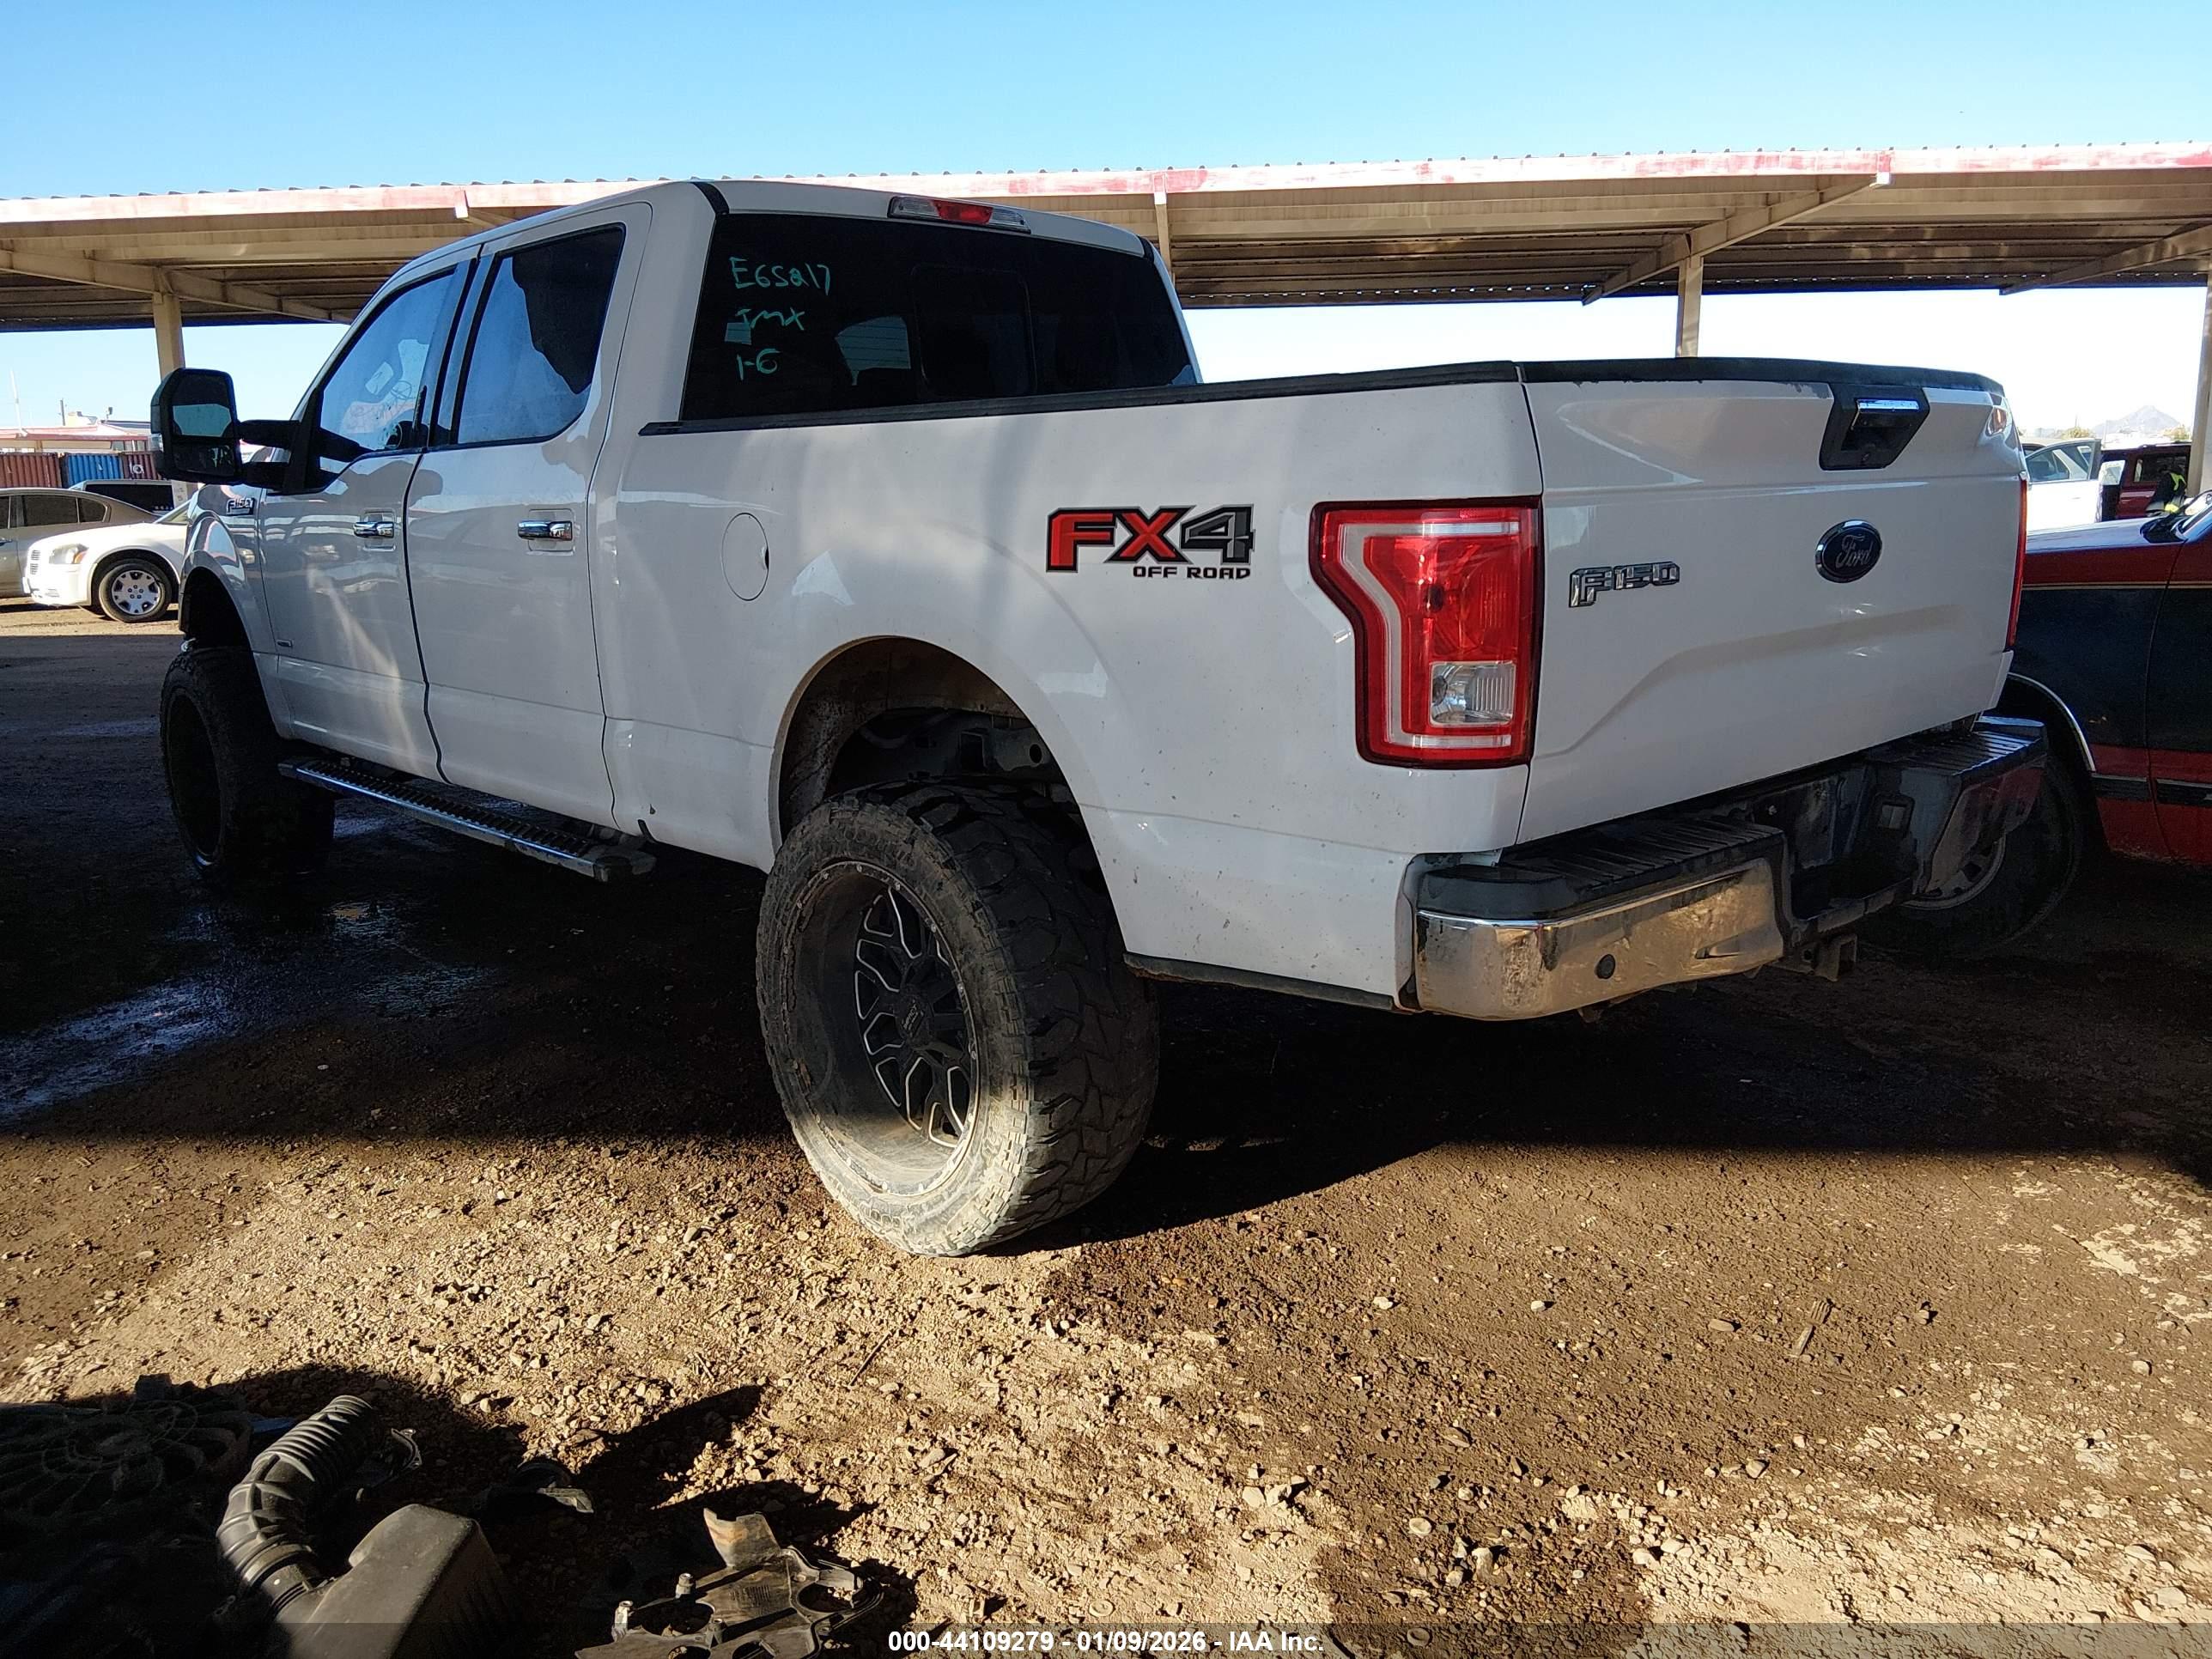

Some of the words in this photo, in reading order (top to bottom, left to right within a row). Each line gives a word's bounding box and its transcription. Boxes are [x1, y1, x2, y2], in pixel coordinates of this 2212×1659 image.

[1045, 503, 1256, 574] FX4
[1133, 565, 1178, 579] OFF
[1187, 566, 1251, 580] ROAD
